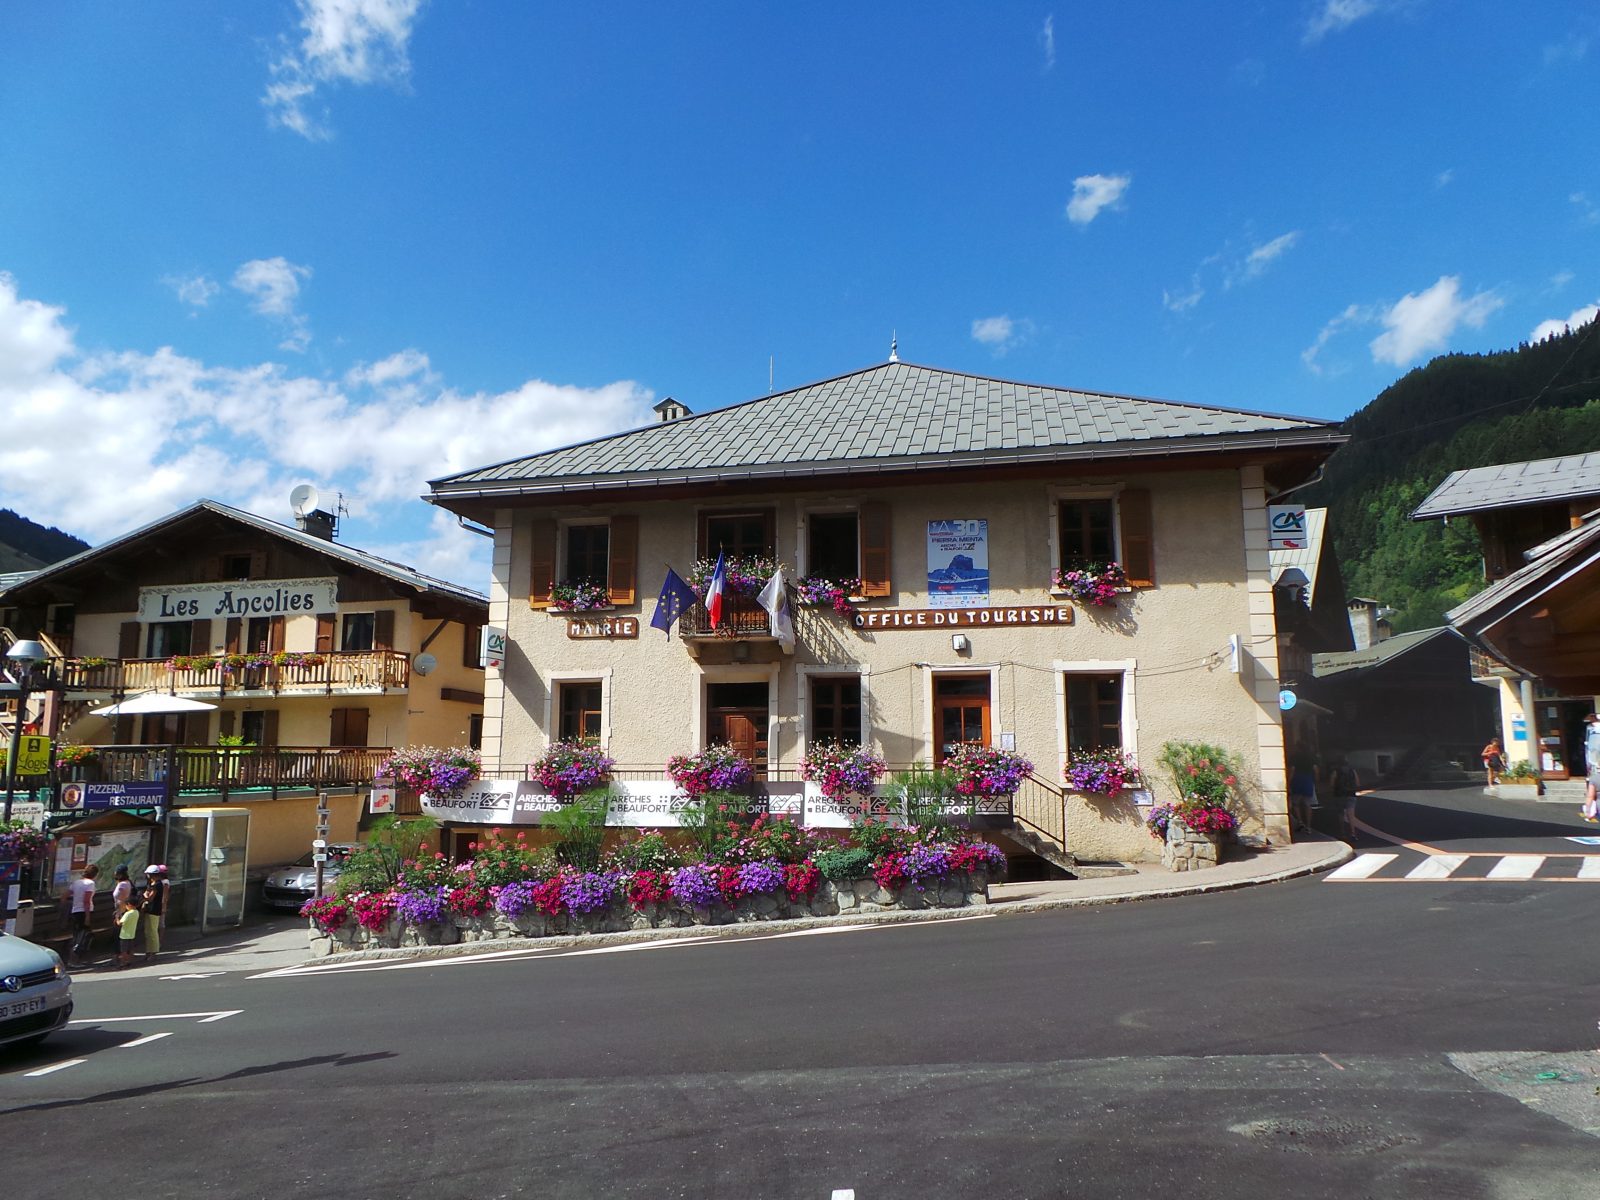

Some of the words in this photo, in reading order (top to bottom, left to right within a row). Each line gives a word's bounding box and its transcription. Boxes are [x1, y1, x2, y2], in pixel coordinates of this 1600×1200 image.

[160, 594, 199, 618] Les
[214, 588, 314, 617] Ancolies
[855, 610, 927, 627] OFFICE
[934, 612, 959, 625] DU
[966, 607, 1068, 623] TOURISME
[571, 620, 632, 635] MAIRIE
[17, 753, 48, 773] Logis
[87, 784, 126, 794] PIZZERIA
[109, 794, 163, 806] RESTAURANT
[430, 799, 478, 810] BEAUFORT
[517, 794, 558, 804] ARECHES
[611, 795, 652, 804] ARECHES
[808, 795, 851, 805] ARECHES
[617, 804, 668, 813] BEAUFORT
[815, 804, 867, 815] BEAUFOR
